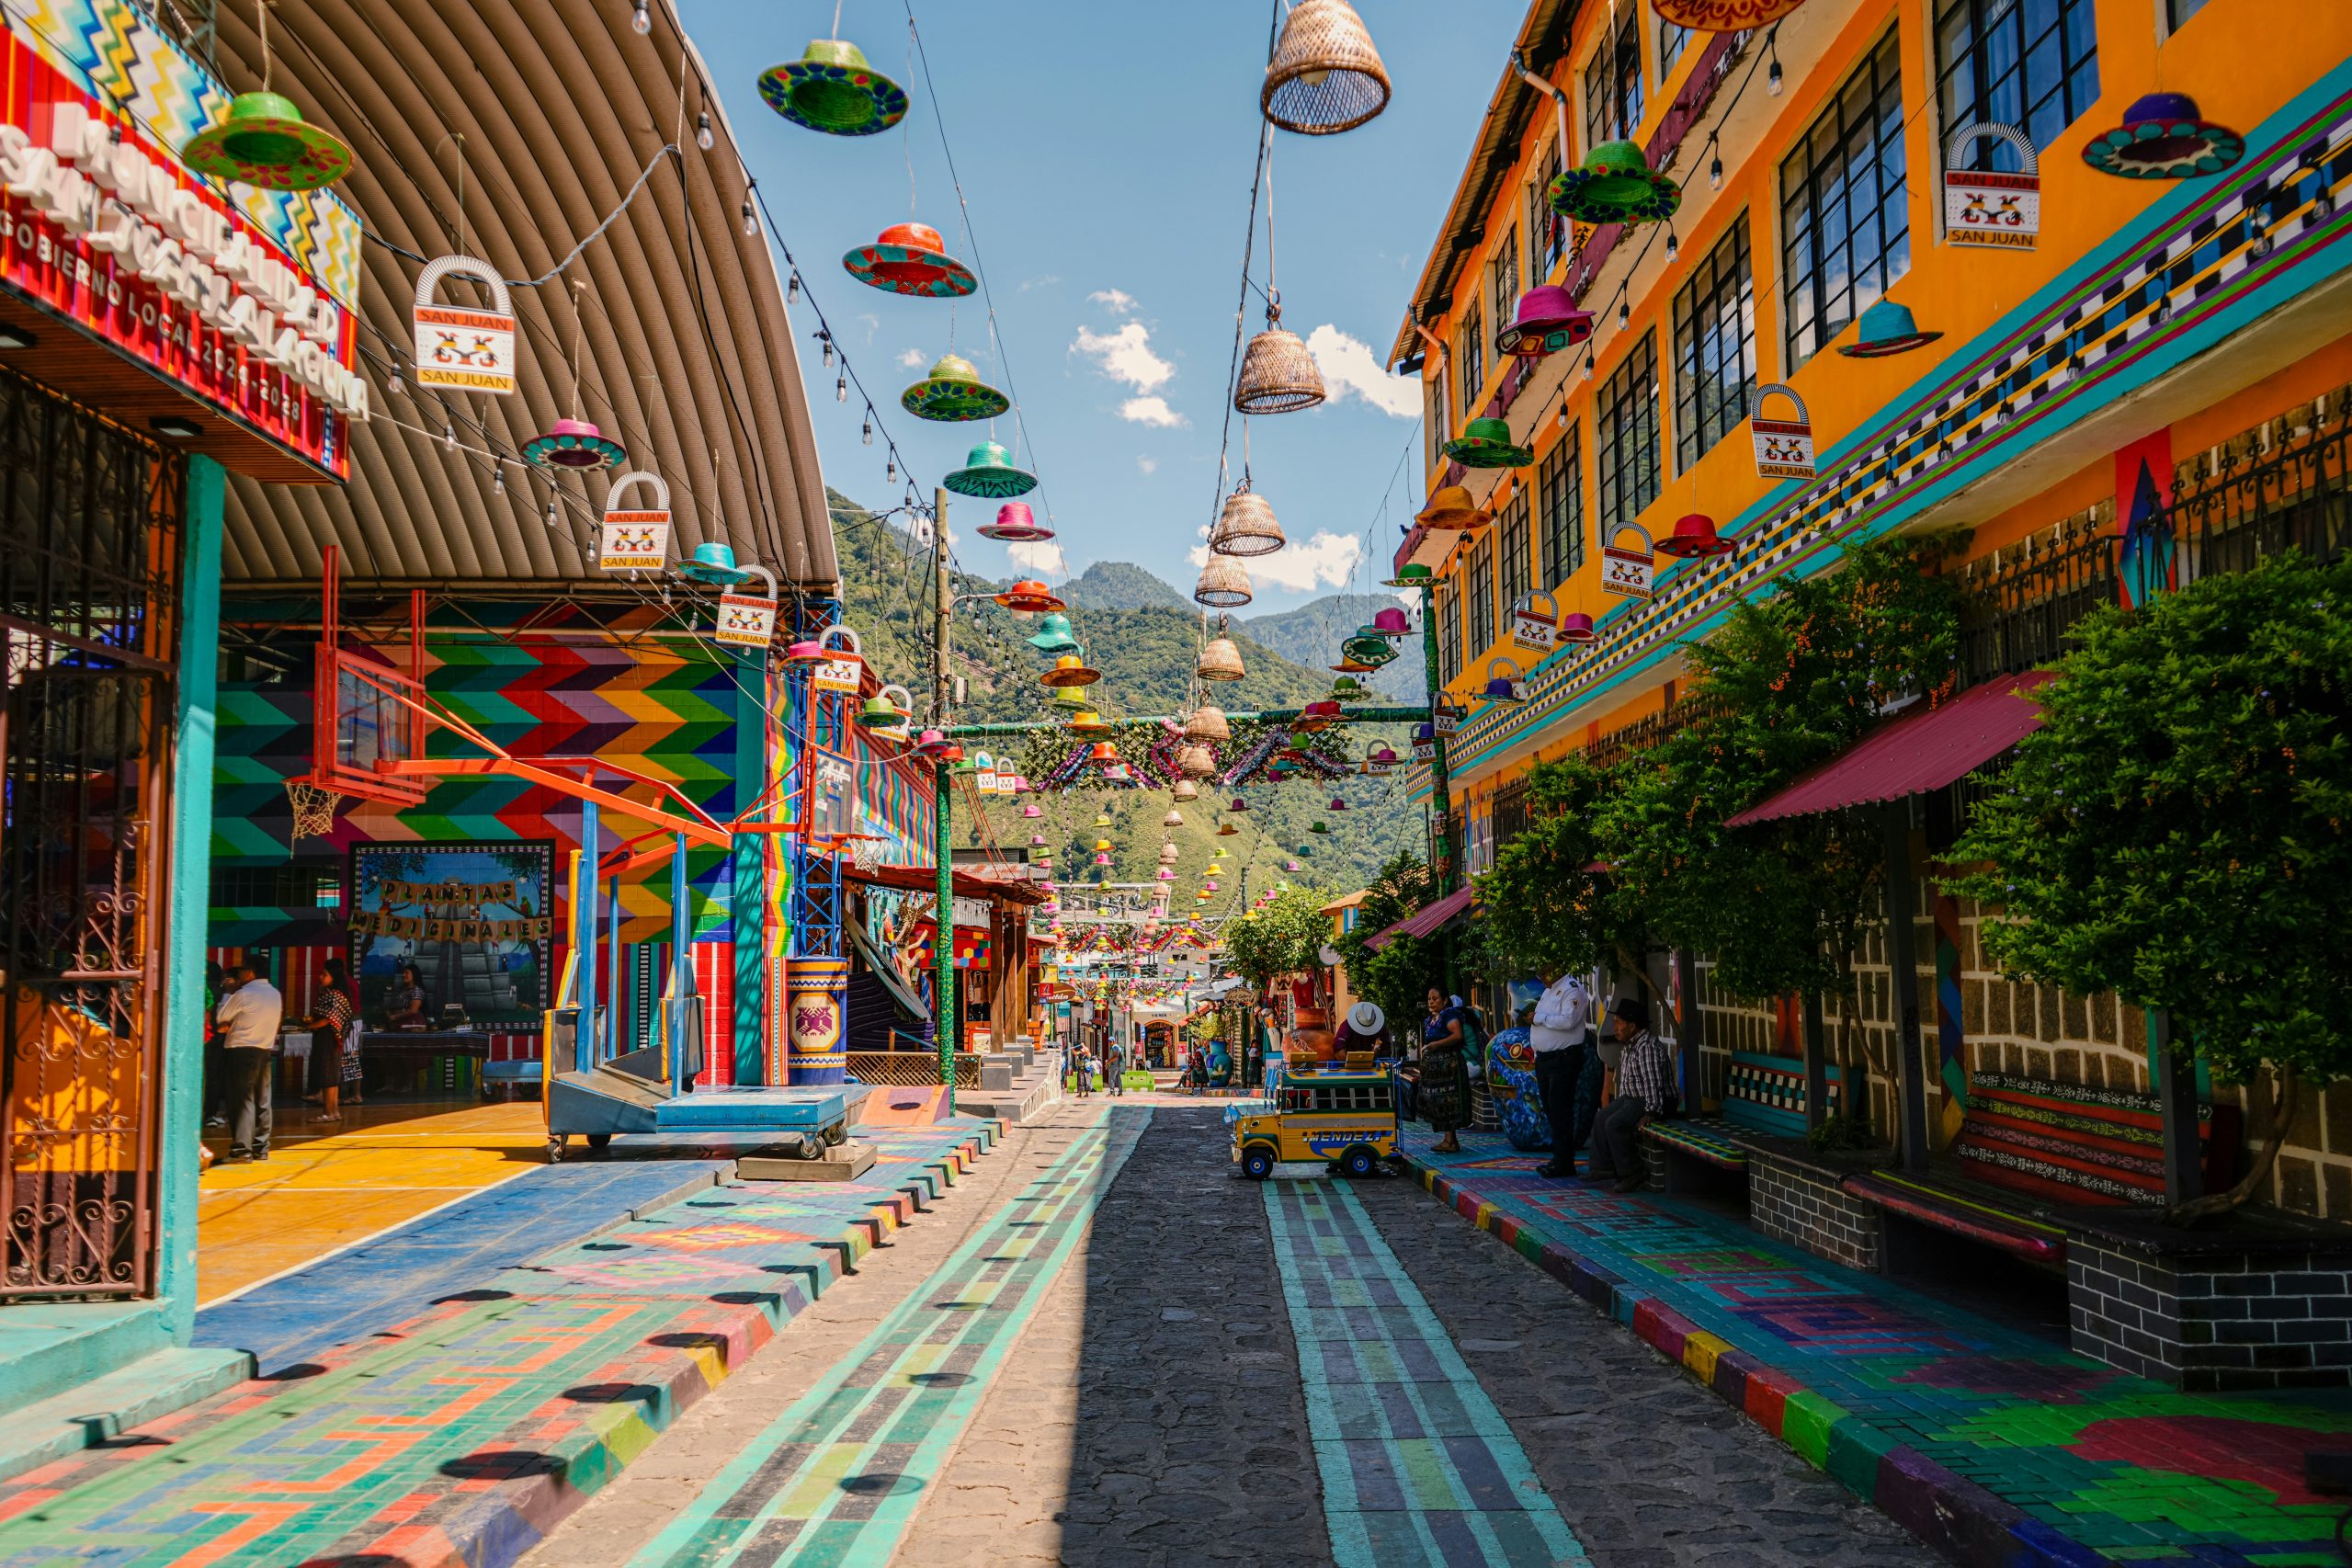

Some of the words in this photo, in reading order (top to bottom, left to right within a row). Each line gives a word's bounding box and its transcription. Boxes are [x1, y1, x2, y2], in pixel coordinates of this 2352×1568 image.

[1951, 173, 1985, 186] SAN
[1991, 175, 2035, 189] JUAN
[51, 102, 339, 345] MUNICIPALIDAD
[1951, 230, 1985, 243] SAN
[1990, 233, 2033, 246] JUAN
[0, 123, 101, 237] SAN
[86, 197, 213, 309] JUAN
[246, 309, 369, 422] LAGUNA
[0, 210, 122, 307] GOBIERNO
[129, 291, 198, 355] LOCAL
[421, 309, 457, 324] SAN
[462, 314, 508, 331] JUAN
[422, 369, 458, 386] SAN
[462, 374, 507, 389] JUAN
[1760, 465, 1783, 474] SAN
[1786, 467, 1812, 477] JUAN
[608, 512, 632, 522] SAN
[635, 513, 666, 522] JUAN
[604, 557, 628, 567] SAN
[630, 557, 660, 567] JUAN
[1605, 582, 1623, 593] SAN
[1625, 585, 1649, 597] JUAN
[724, 597, 744, 606] SAN
[746, 599, 773, 609] JUAN
[719, 631, 739, 641] SAN
[741, 634, 767, 645] JUAN
[1515, 638, 1530, 648] SAN
[1531, 642, 1551, 653] JUAN
[835, 682, 857, 691] JUAN
[383, 882, 512, 901] PLANTAS
[350, 912, 550, 937] MEDICINALES
